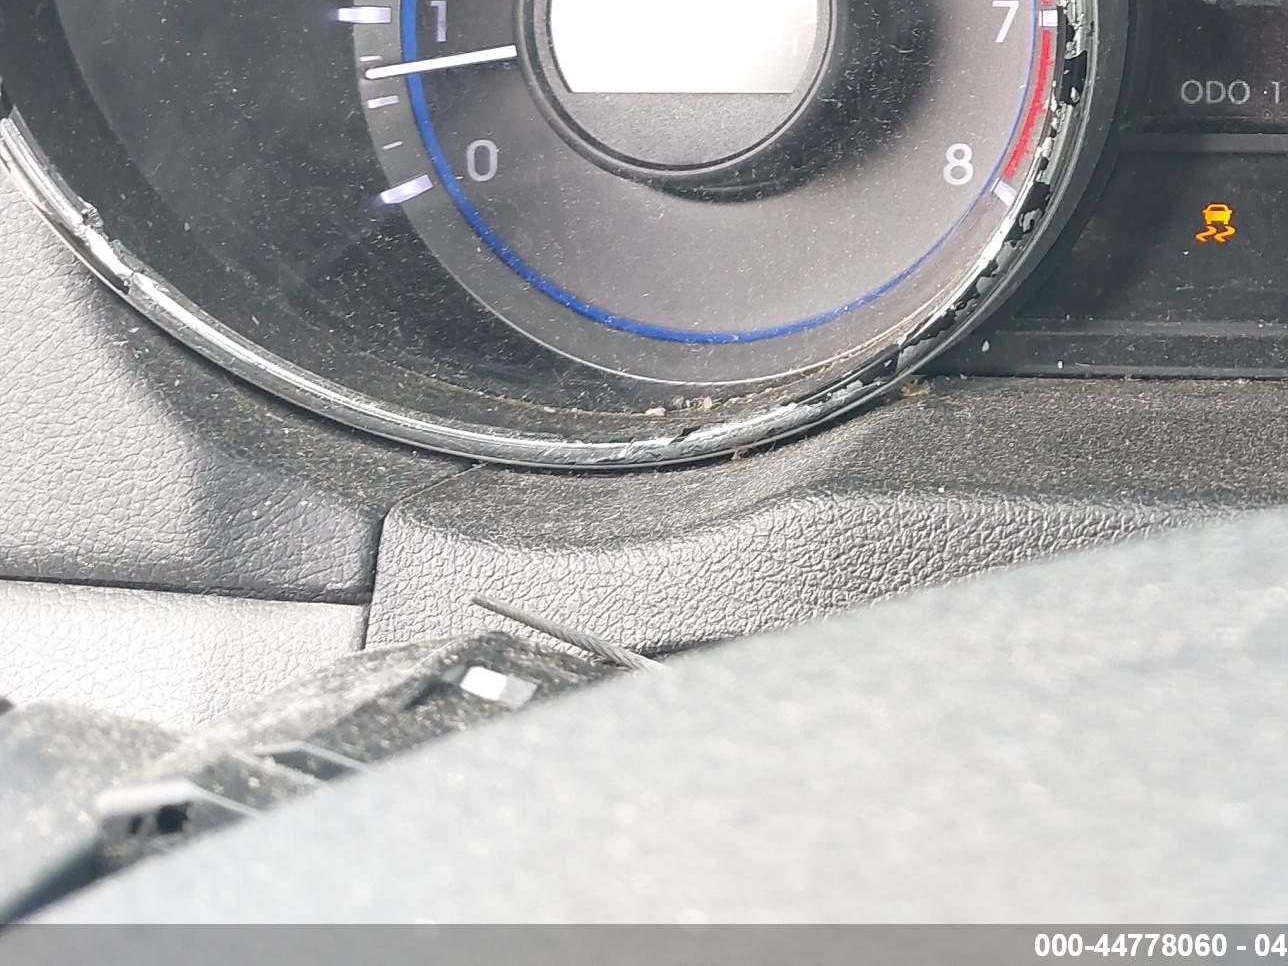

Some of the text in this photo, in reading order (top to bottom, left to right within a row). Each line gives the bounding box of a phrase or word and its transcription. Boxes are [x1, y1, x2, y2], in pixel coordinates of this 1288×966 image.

[428, 0, 447, 43] 1
[991, 0, 1020, 43] 7
[1180, 80, 1251, 105] ODO
[466, 139, 500, 182] 0
[943, 143, 975, 186] 8
